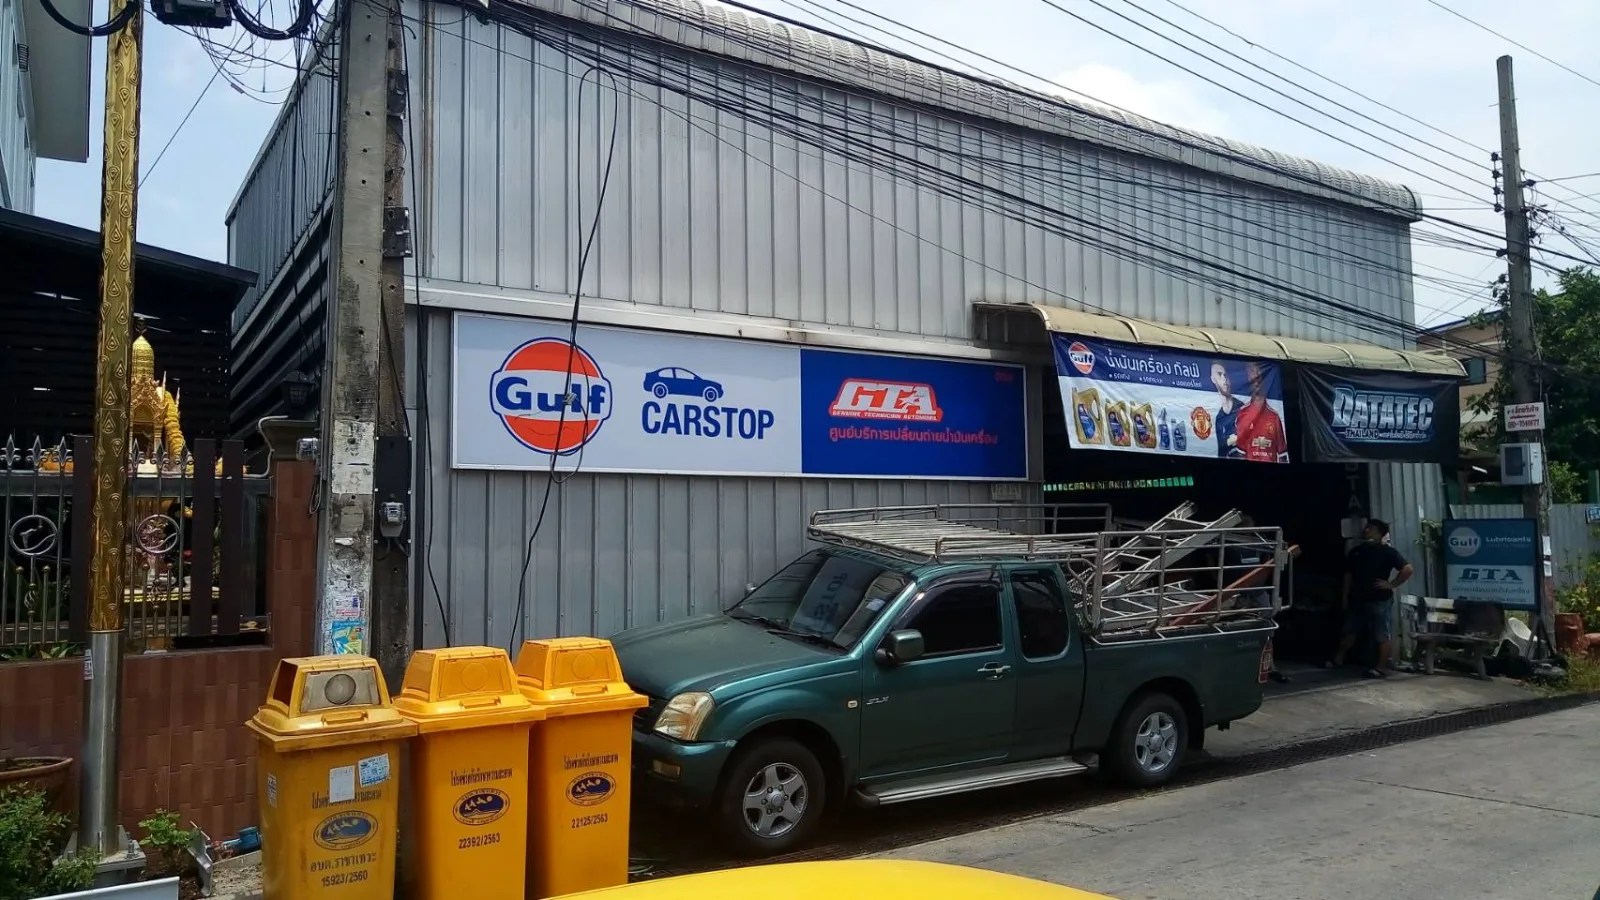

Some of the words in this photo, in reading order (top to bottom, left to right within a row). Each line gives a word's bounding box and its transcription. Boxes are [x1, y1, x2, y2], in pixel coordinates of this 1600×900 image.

[1070, 352, 1093, 364] Gulf
[1104, 348, 1172, 375] น้ำมันเครื่อง
[495, 376, 606, 414] Gulf
[833, 381, 937, 415] GTA
[1331, 387, 1434, 431] DATATEC
[641, 401, 775, 440] CARSTOP
[829, 424, 998, 445] ศูนย์บริการเปลี่ยนถ่ายน้ำมันเครื่อง
[1345, 428, 1380, 439] THAILAND
[1450, 537, 1479, 547] Gulf
[1458, 567, 1522, 581] GTA
[458, 832, 501, 849] 22392/2563
[321, 869, 368, 888] 15923/2560
